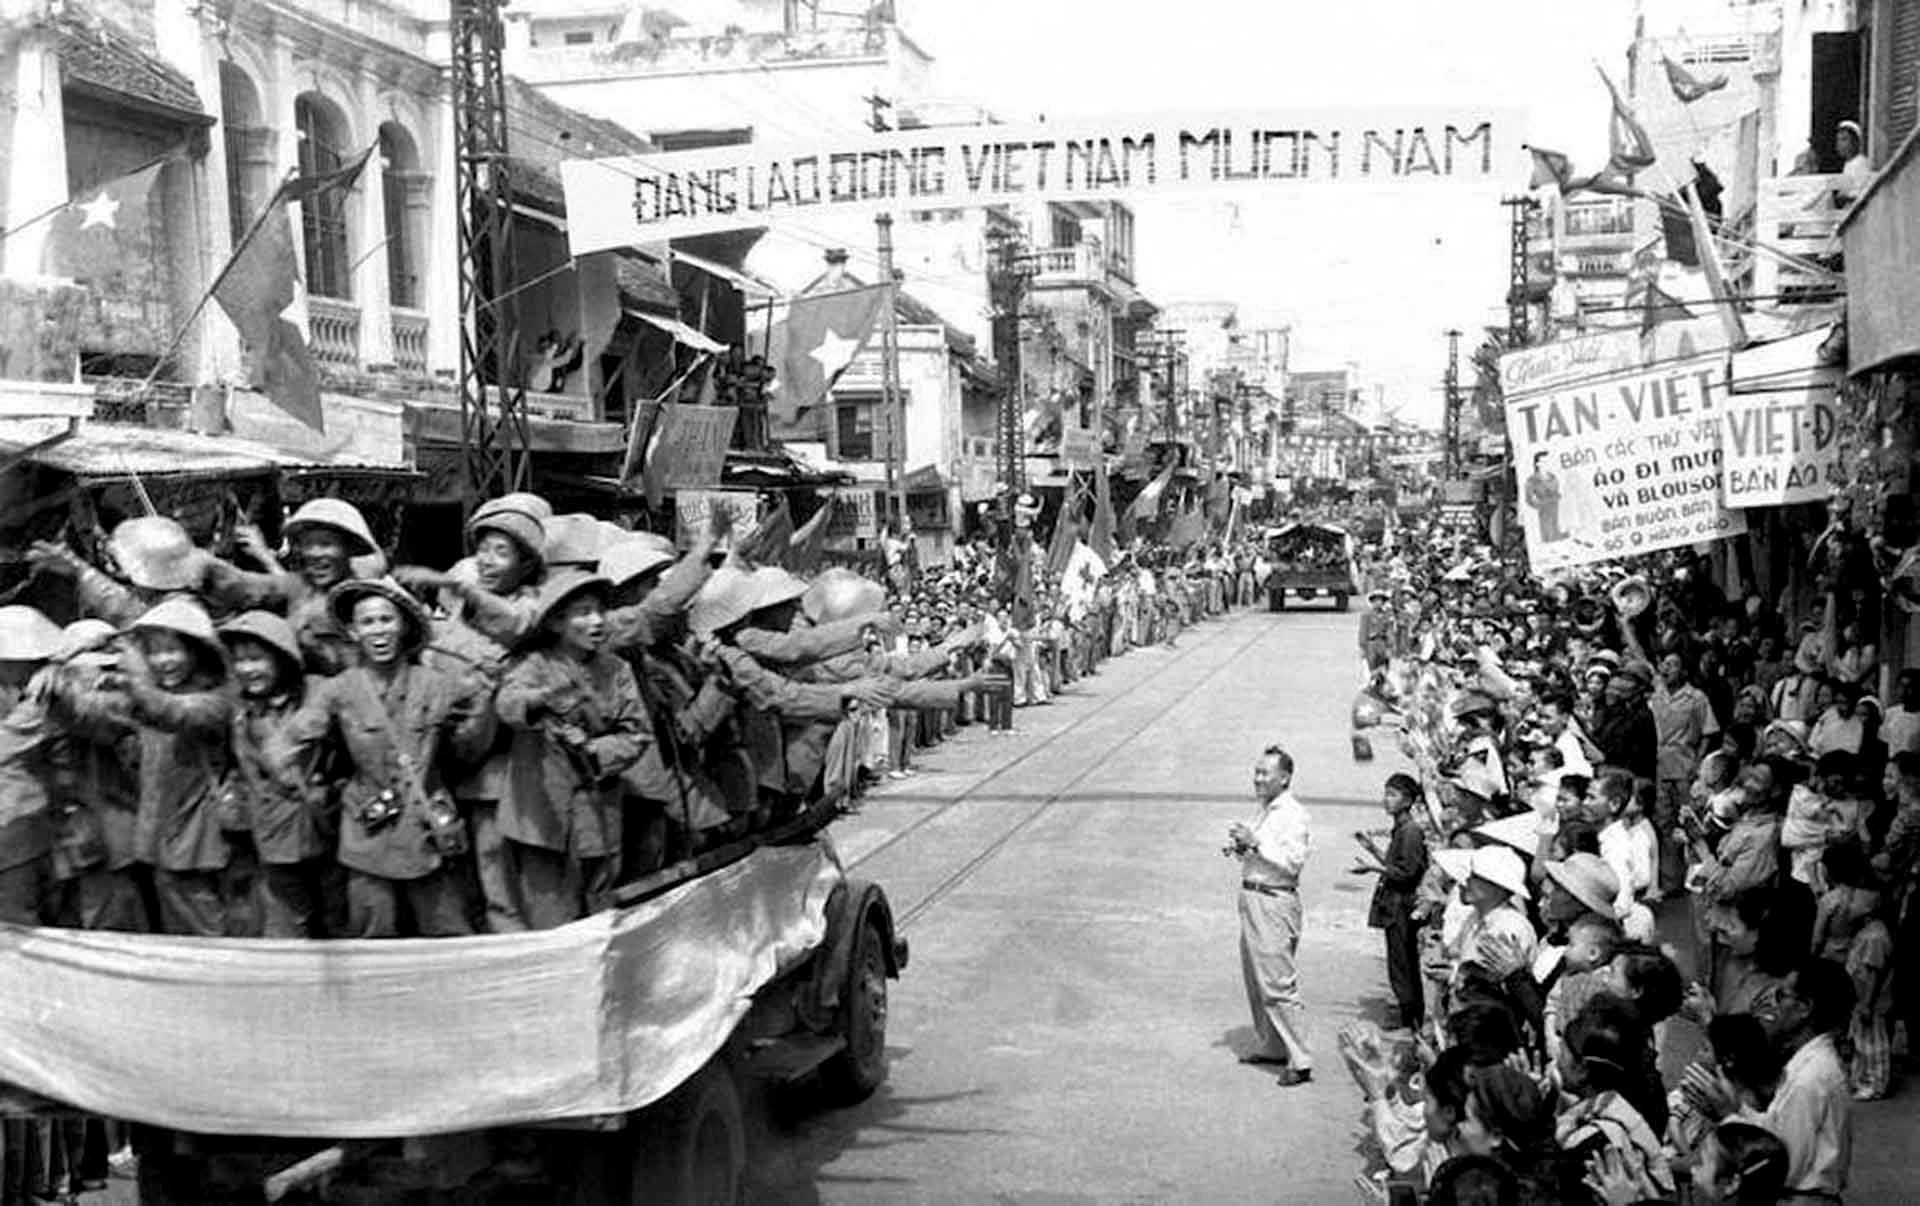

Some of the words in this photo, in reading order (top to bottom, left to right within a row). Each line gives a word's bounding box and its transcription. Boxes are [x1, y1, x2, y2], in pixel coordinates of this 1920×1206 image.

[747, 154, 822, 211] LAO
[1066, 131, 1156, 191] NAM
[1361, 121, 1493, 177] NAM
[1634, 460, 1661, 480] ĐI
